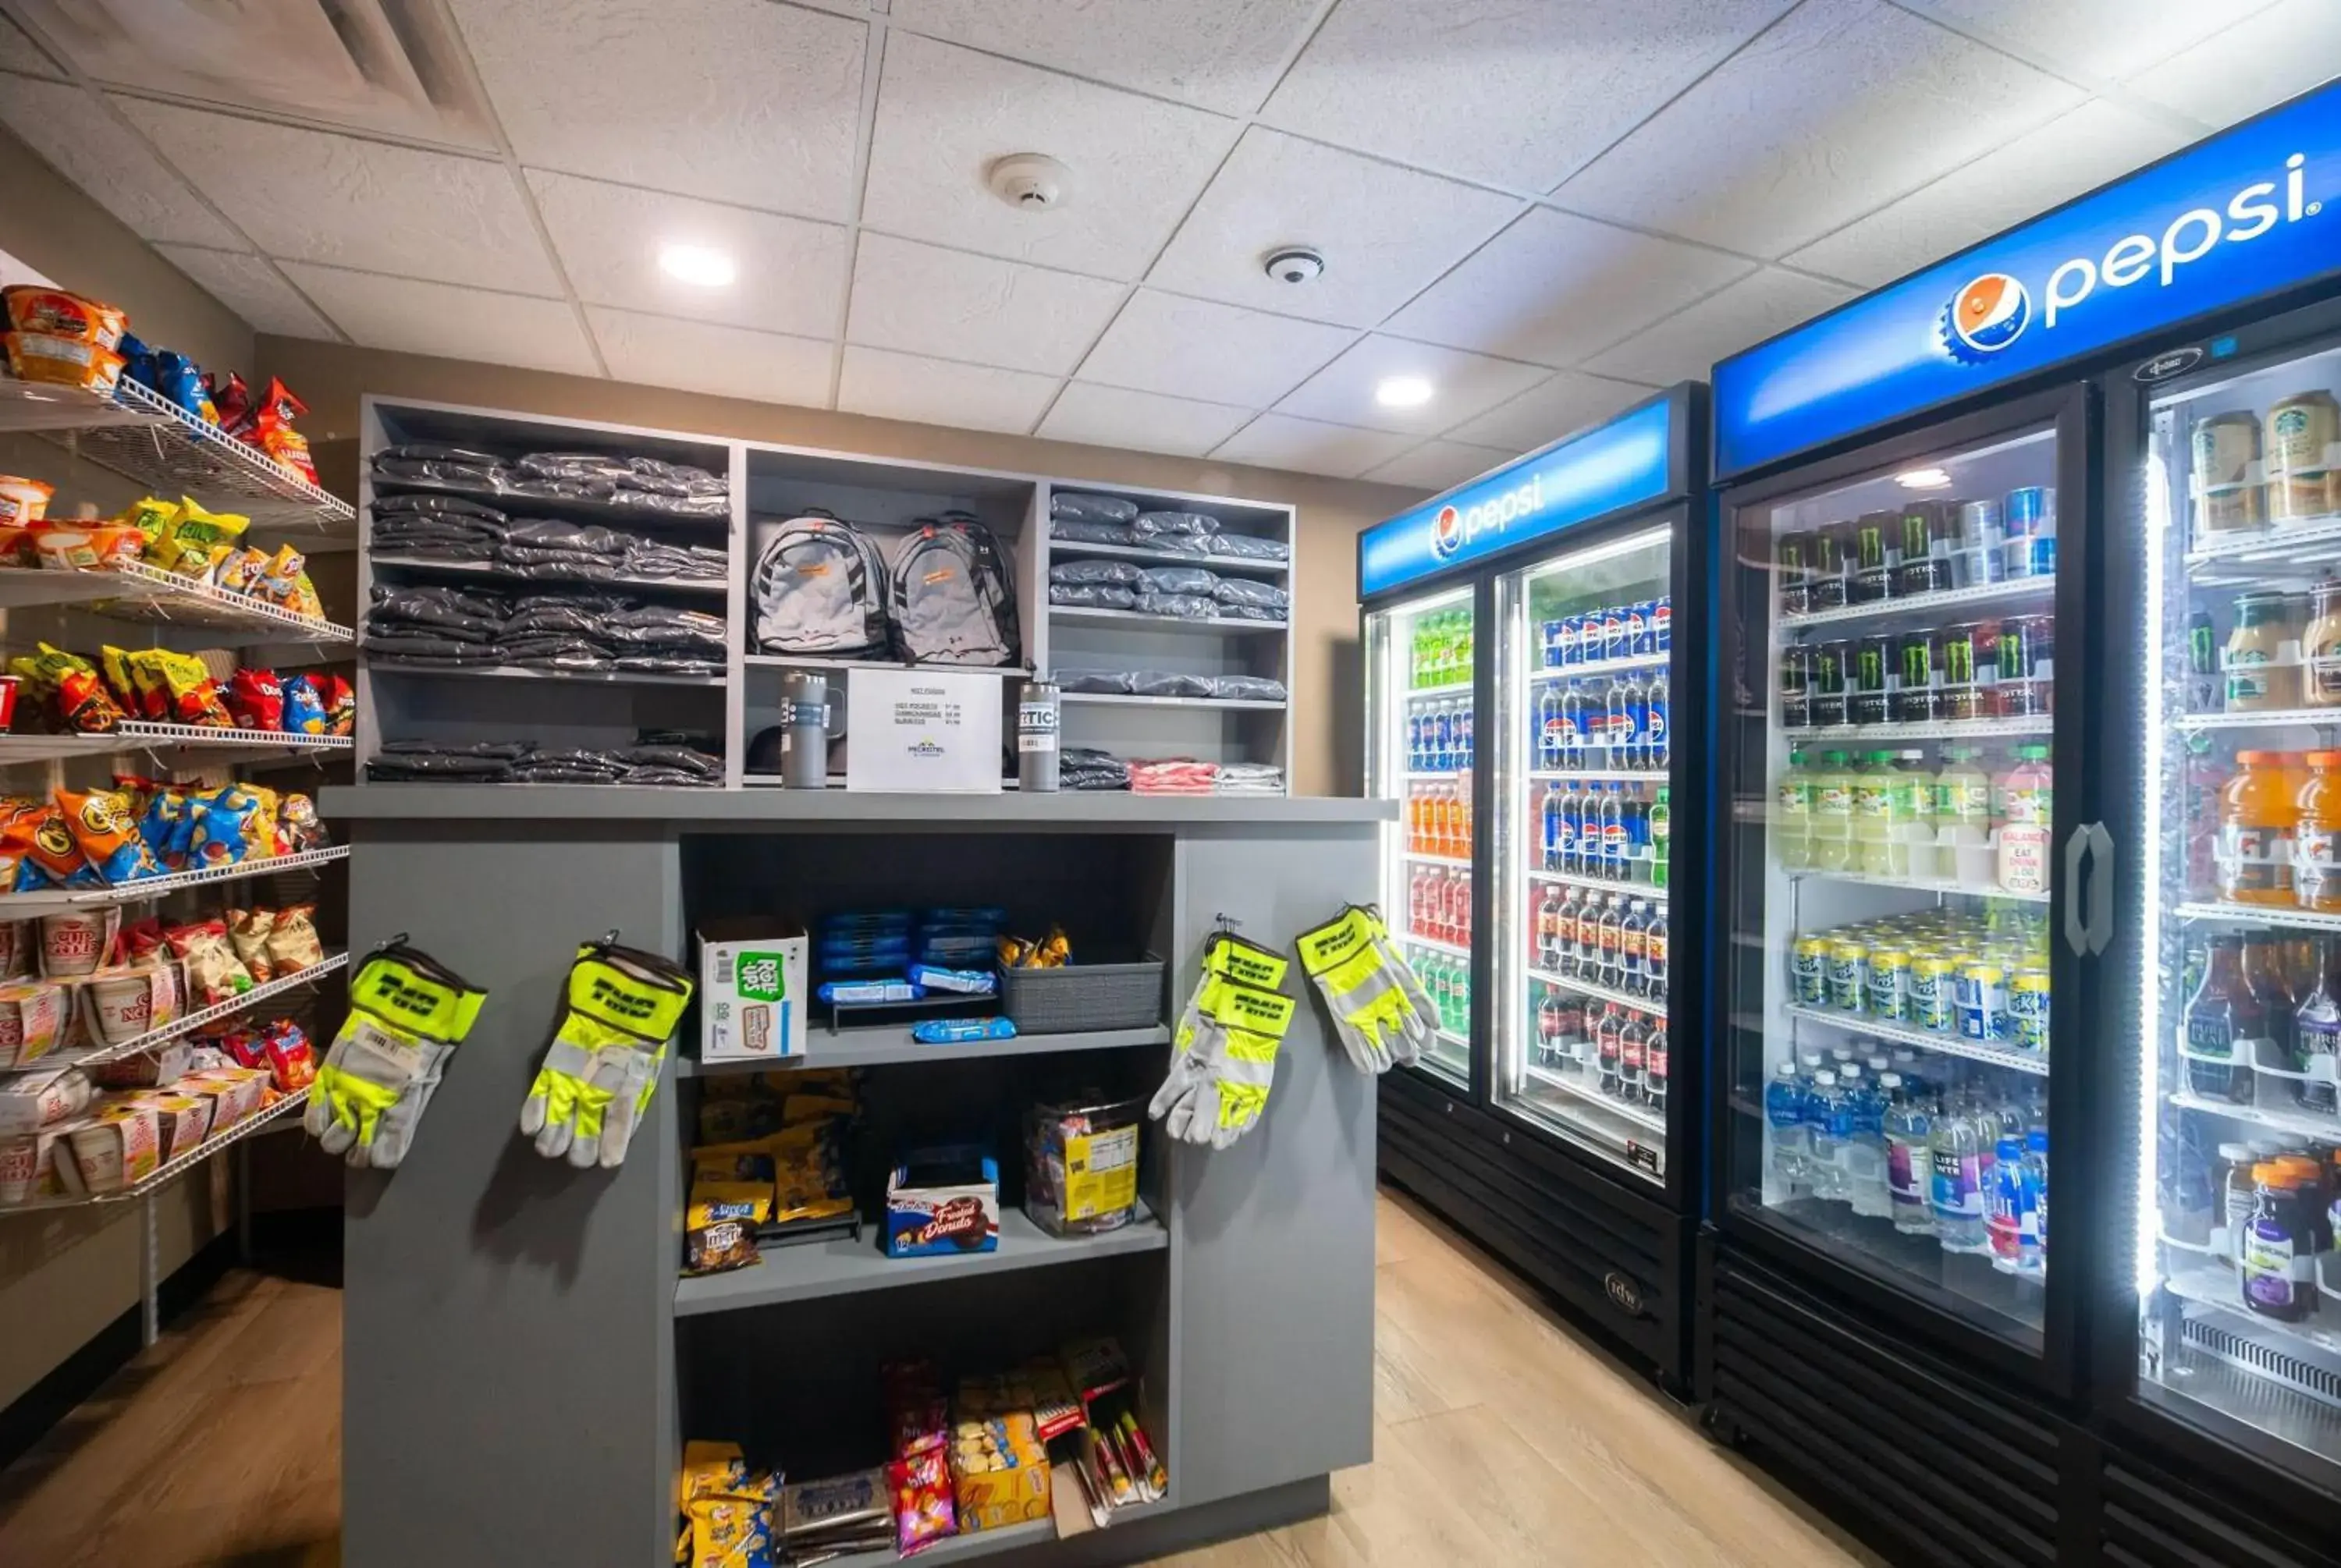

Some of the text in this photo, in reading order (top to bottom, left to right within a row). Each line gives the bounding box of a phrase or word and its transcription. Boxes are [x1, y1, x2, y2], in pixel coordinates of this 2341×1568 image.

[2045, 152, 2305, 328] pepsi
[1465, 474, 1545, 544] pepsi
[924, 1218, 972, 1240] Donuts
[936, 1204, 975, 1223] Frosted
